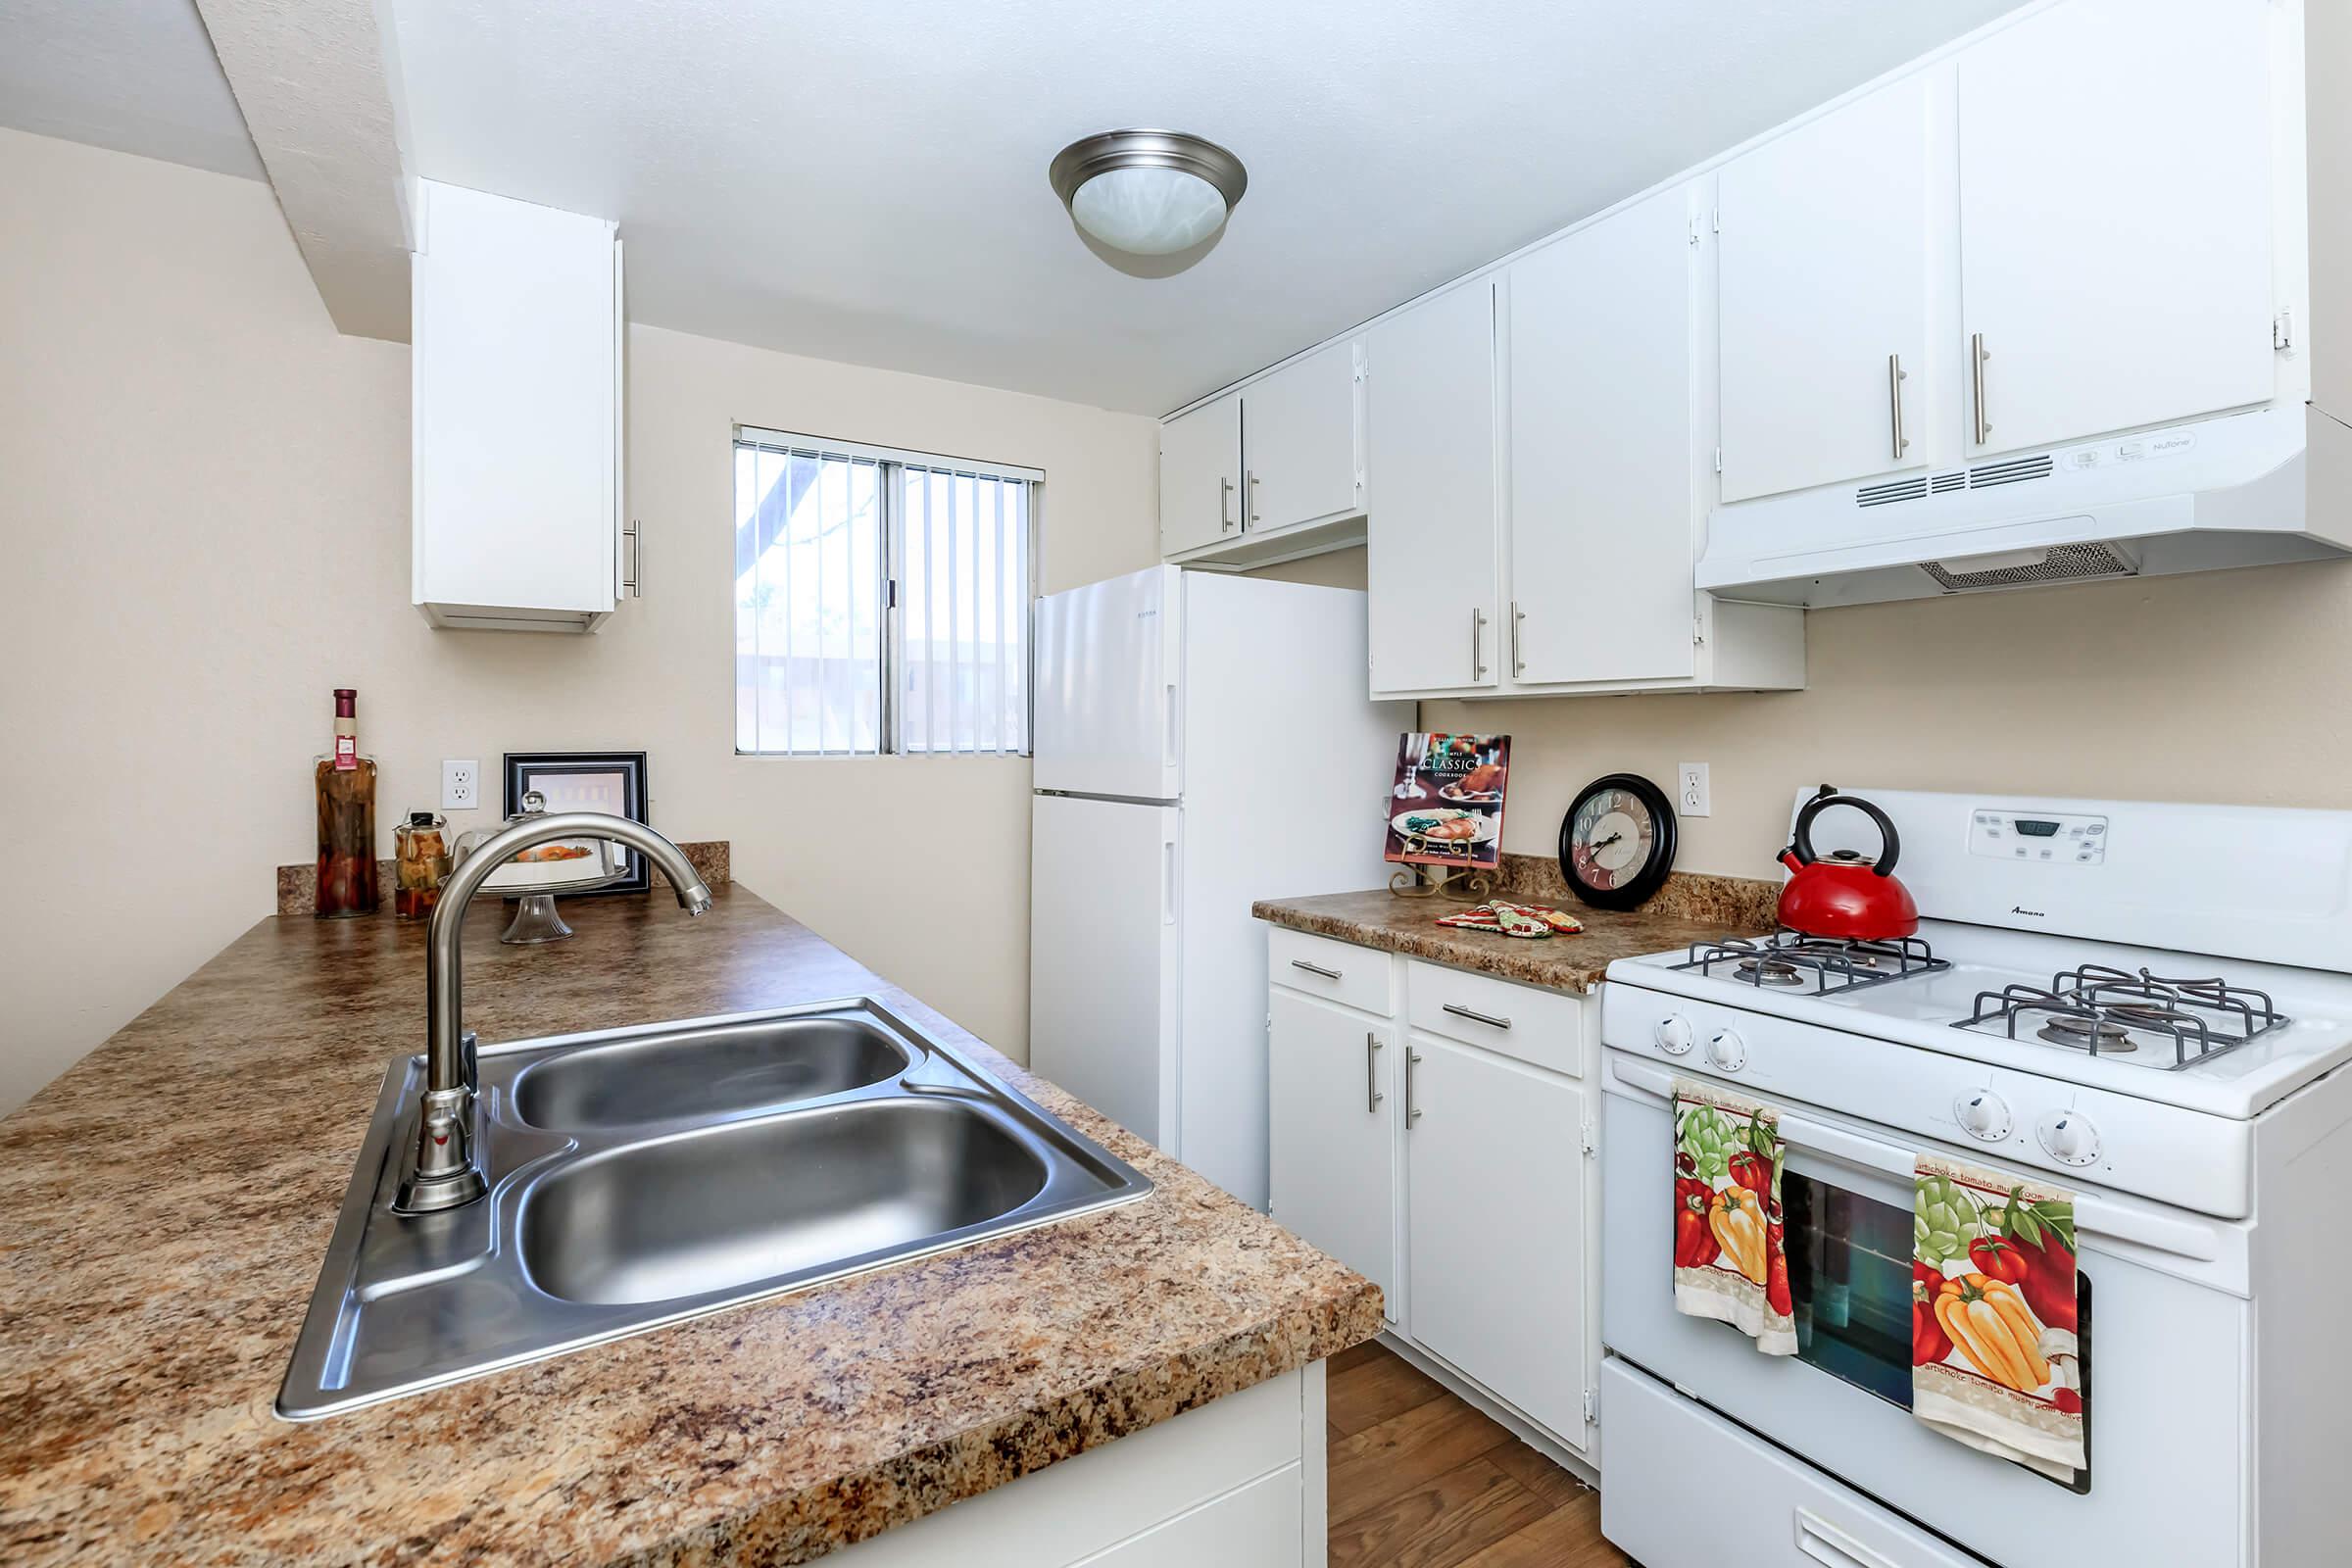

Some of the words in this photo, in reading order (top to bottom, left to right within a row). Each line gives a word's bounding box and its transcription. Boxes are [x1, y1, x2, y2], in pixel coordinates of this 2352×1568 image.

[2154, 439, 2190, 451] NuTone
[1423, 759, 1481, 770] CLASSICS
[1608, 794, 1622, 808] 12
[1630, 797, 1635, 810] 1
[1592, 803, 1602, 815] 11
[1579, 817, 1592, 832] 10
[1575, 837, 1583, 851] 9
[1579, 856, 1587, 870] 8
[1592, 868, 1599, 883] 7
[1609, 872, 1617, 887] 6
[2011, 906, 2045, 917] Amana
[1916, 1163, 1956, 1178] artichoke
[1961, 1173, 1993, 1189] tomato
[1924, 1362, 1967, 1383] artichoke
[1971, 1376, 2004, 1396] tomato
[2008, 1392, 2057, 1414] mushroom
